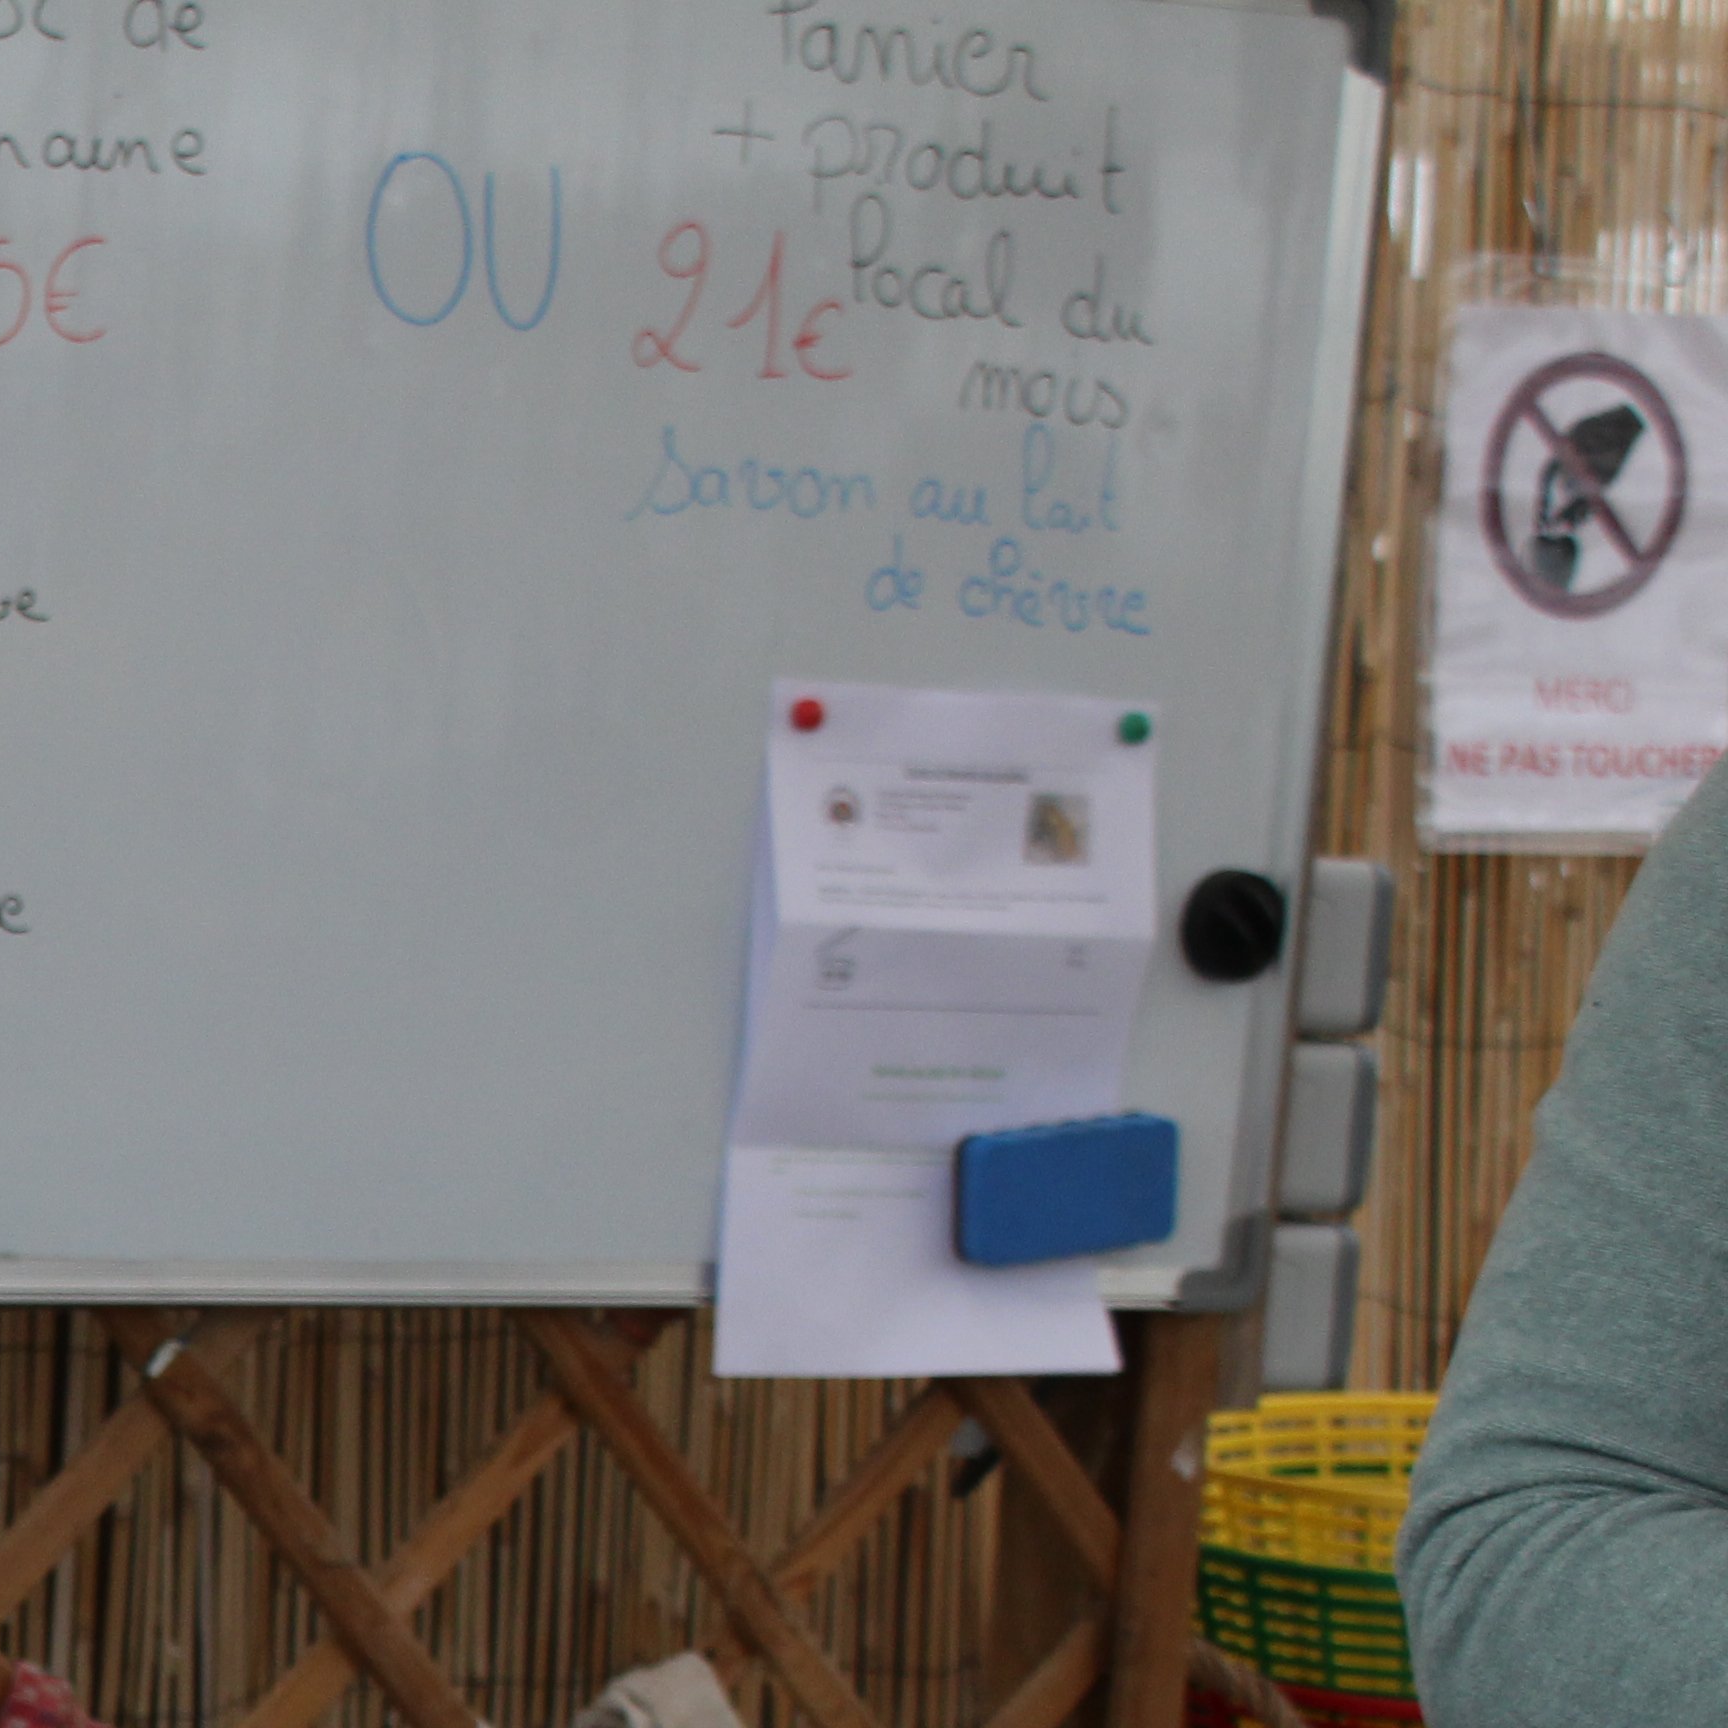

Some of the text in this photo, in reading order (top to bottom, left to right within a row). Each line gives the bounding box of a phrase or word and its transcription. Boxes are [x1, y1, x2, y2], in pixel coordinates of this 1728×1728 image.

[801, 105, 1126, 215] produit
[366, 150, 561, 331] OU
[849, 195, 1154, 346] local du
[630, 221, 855, 382] 21€
[958, 358, 1130, 430] mois
[911, 472, 990, 526] au
[1020, 424, 1122, 534] lait
[864, 535, 924, 612] de
[1446, 741, 1490, 778] NE
[1499, 741, 1561, 778] PAS
